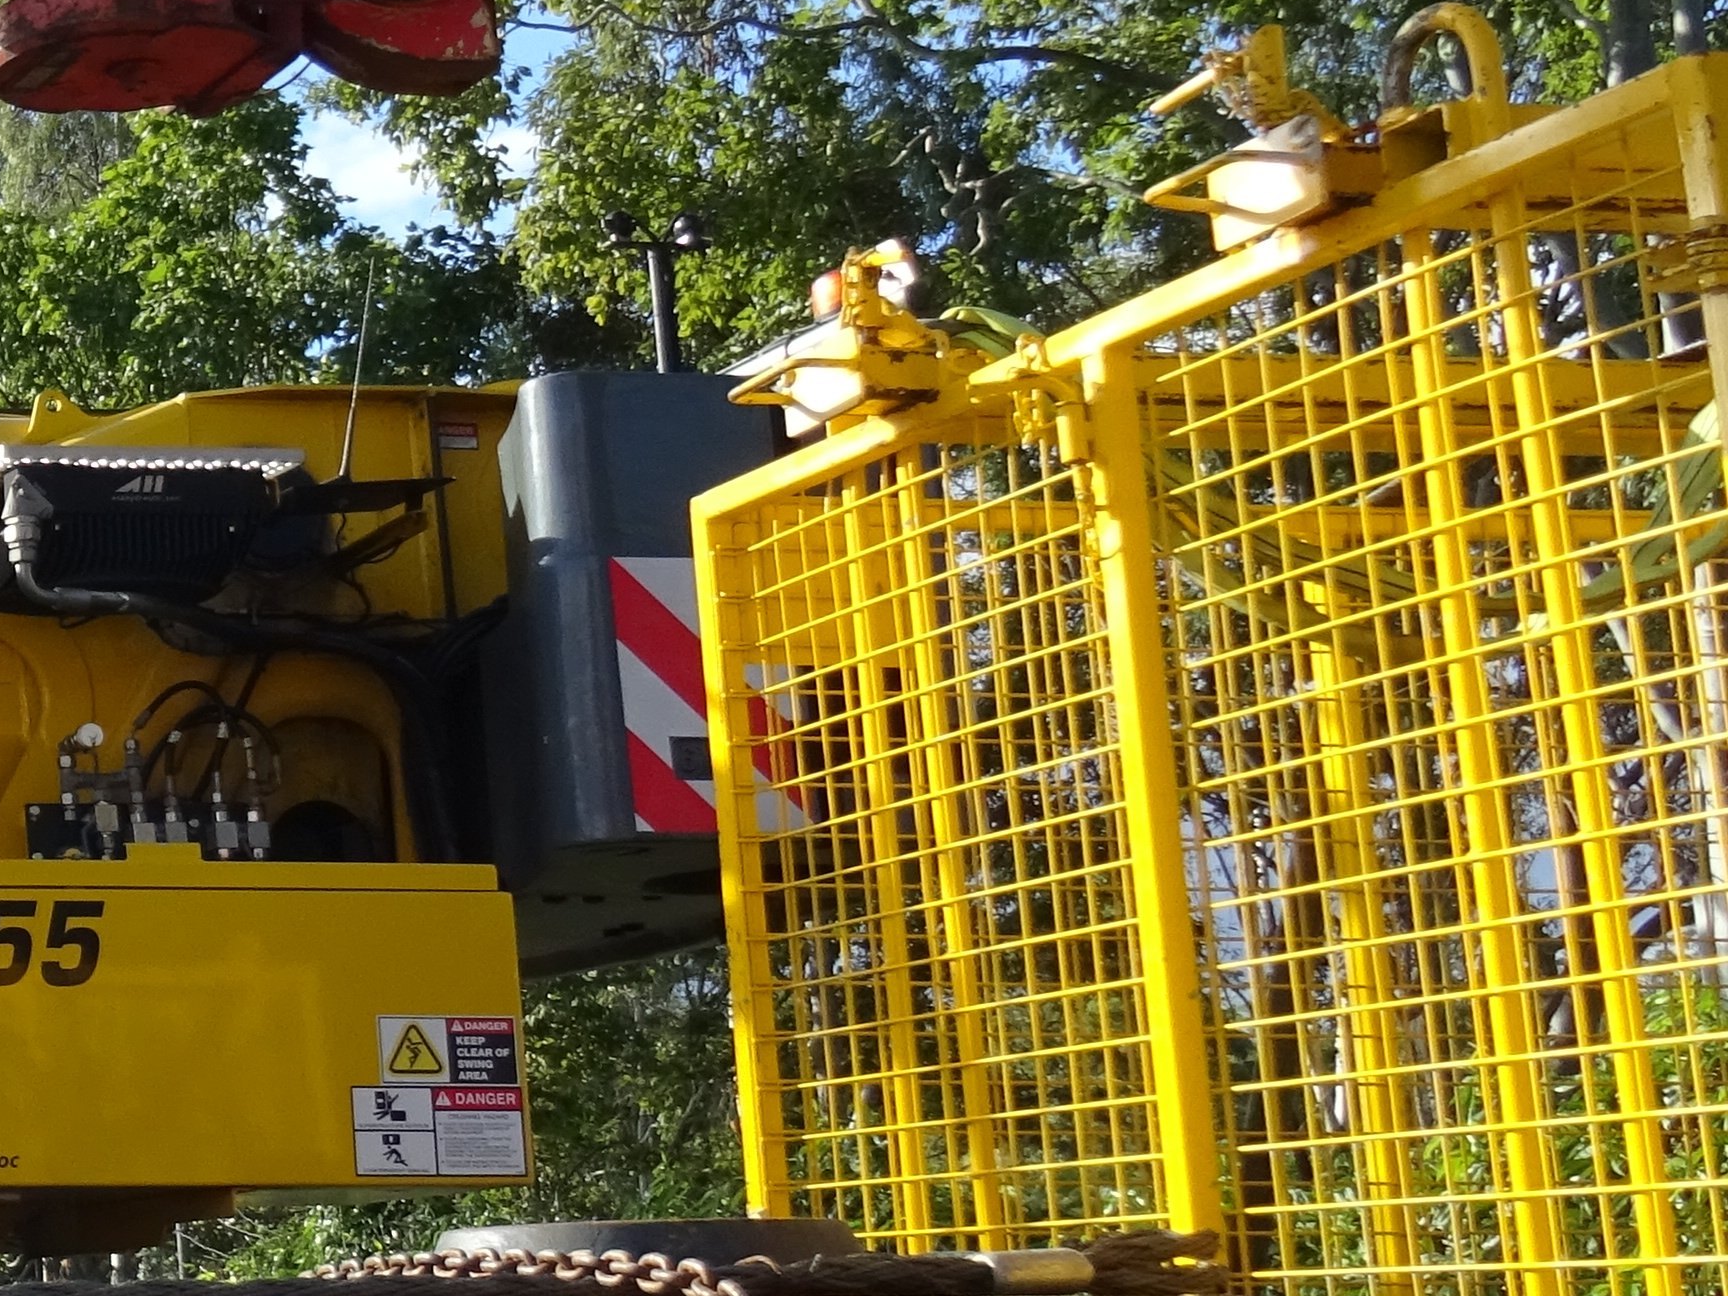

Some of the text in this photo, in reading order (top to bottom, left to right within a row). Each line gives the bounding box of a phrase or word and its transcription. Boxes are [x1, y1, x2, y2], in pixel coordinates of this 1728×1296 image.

[464, 1021, 508, 1030] DANGER
[455, 1036, 486, 1045] KEEP
[456, 1048, 510, 1057] CLEAR OF
[457, 1059, 493, 1069] SWING
[458, 1071, 489, 1080] AREA
[455, 1093, 516, 1105] DANGER
